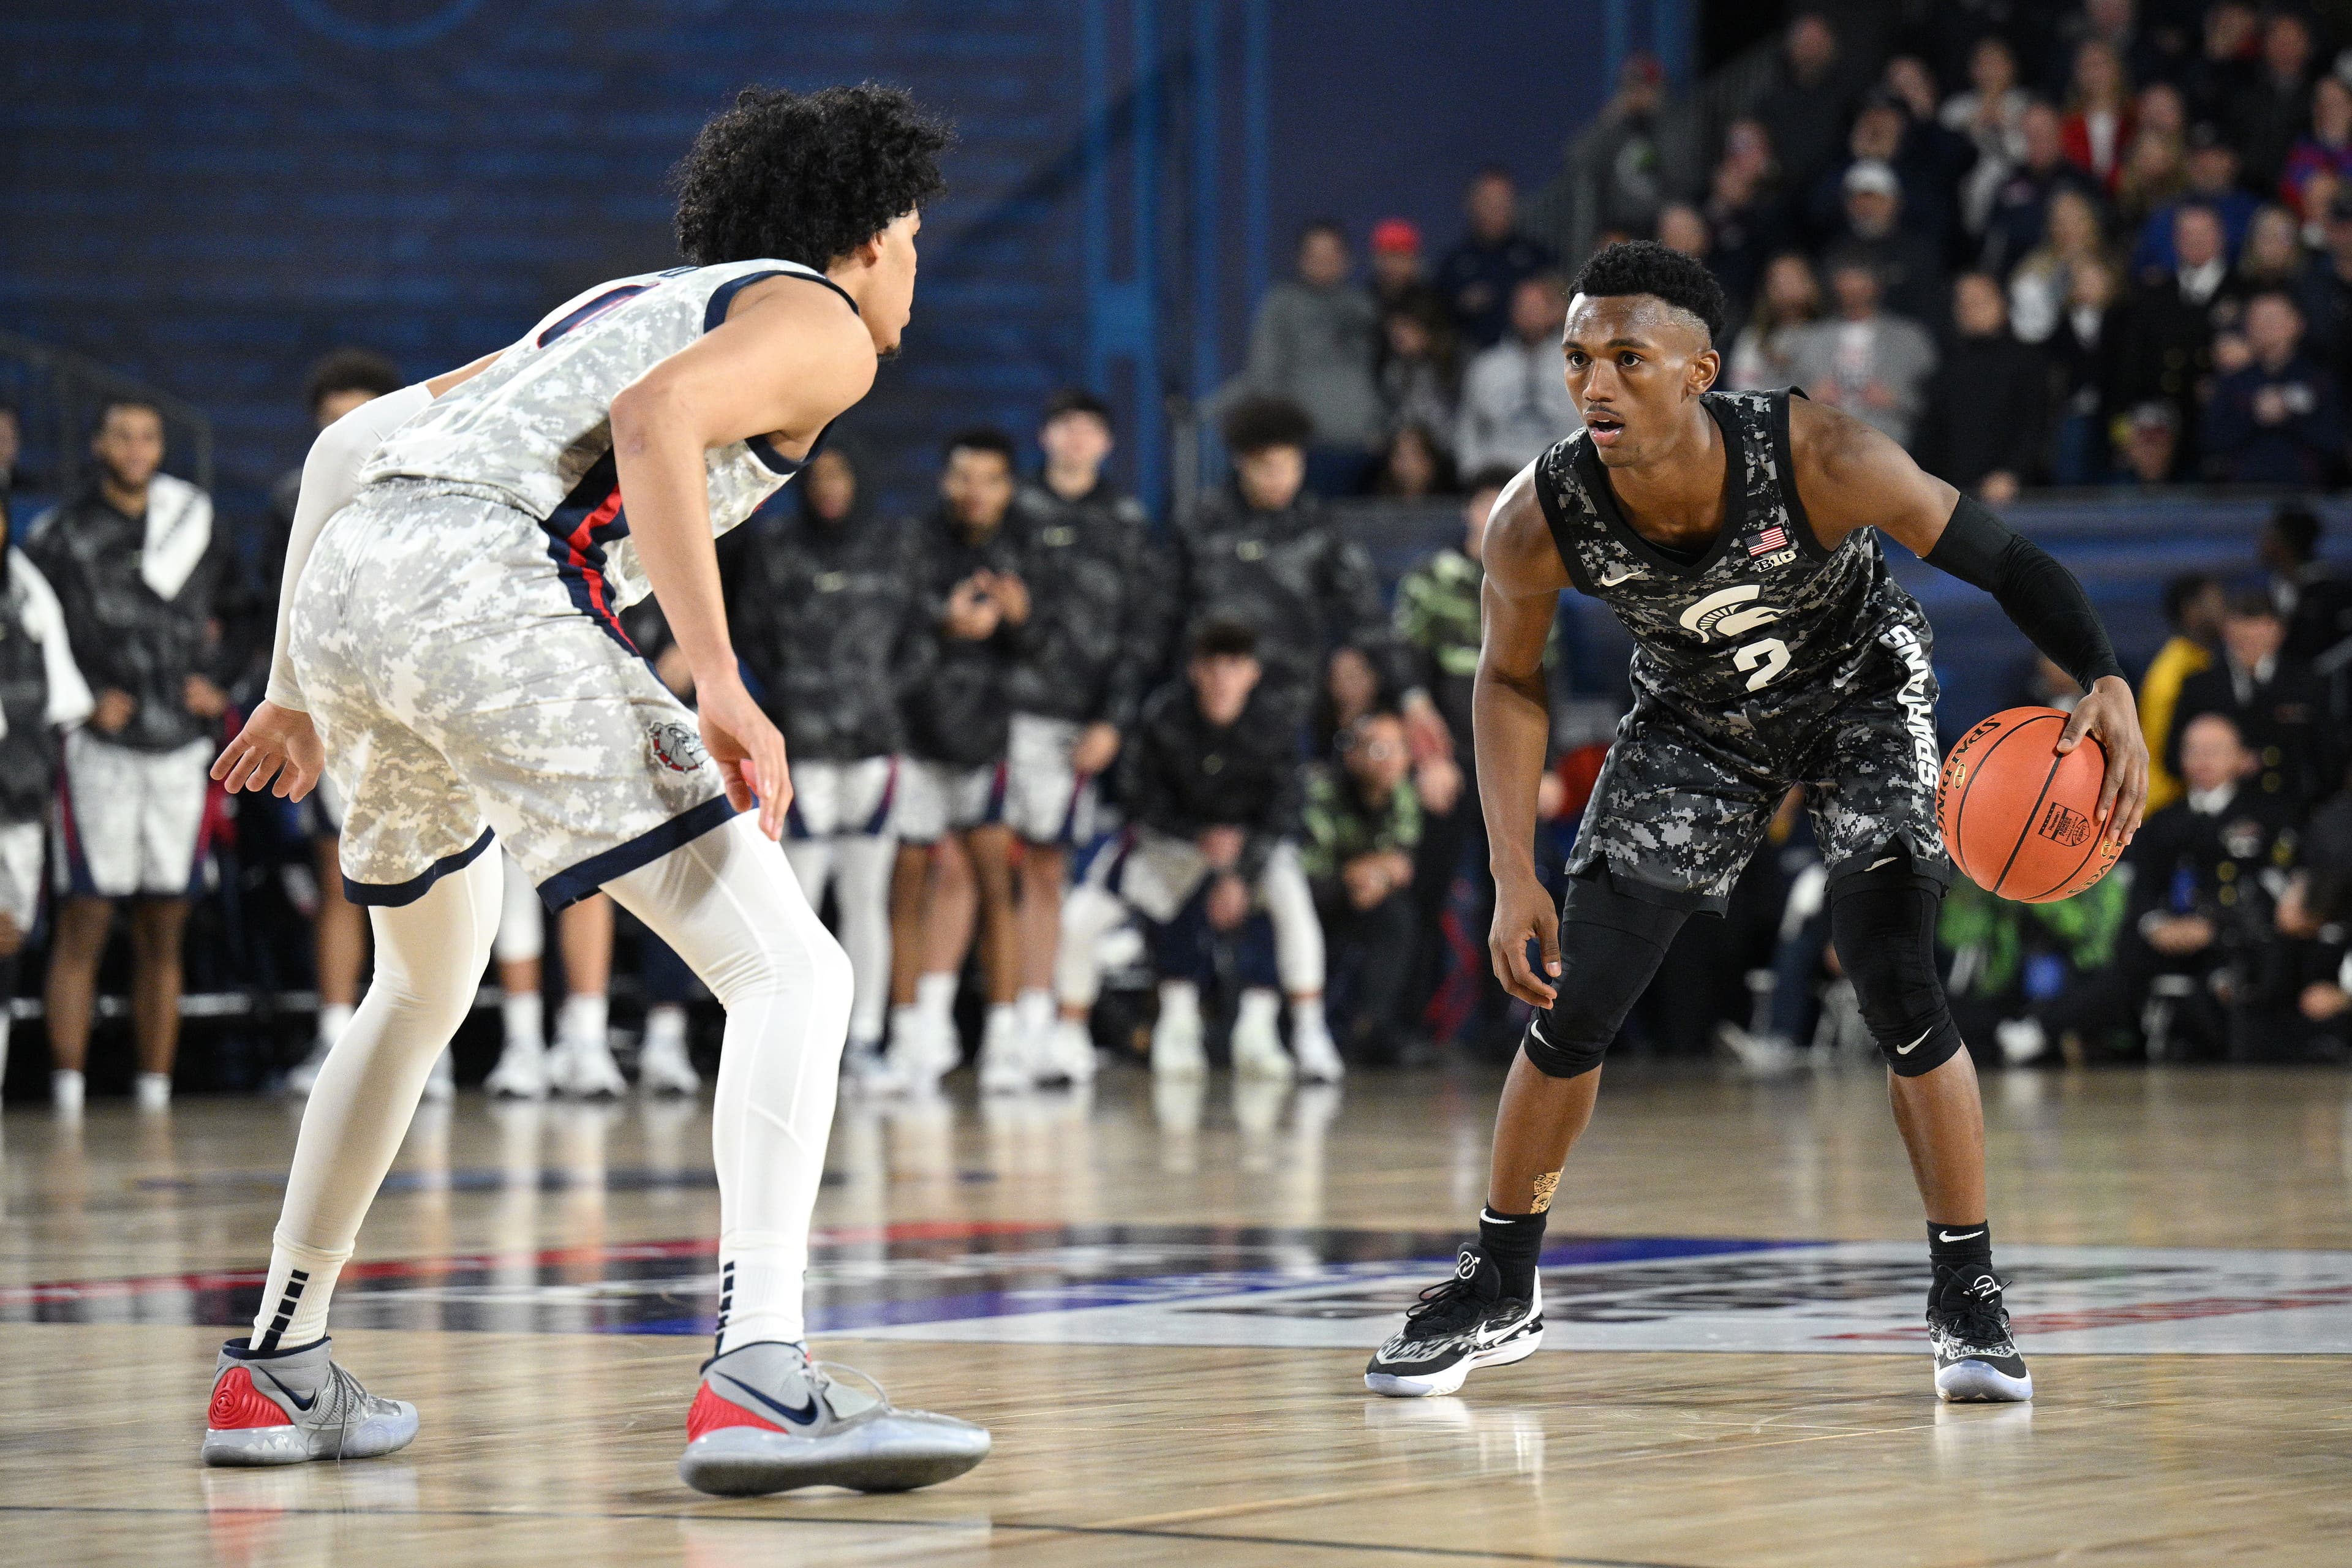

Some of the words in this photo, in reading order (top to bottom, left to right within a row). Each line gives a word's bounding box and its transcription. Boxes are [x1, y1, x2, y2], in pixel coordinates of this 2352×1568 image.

[1732, 637, 1792, 693] 2
[1879, 624, 1940, 790] SPARTANS
[1936, 718, 2002, 837] SPALDING
